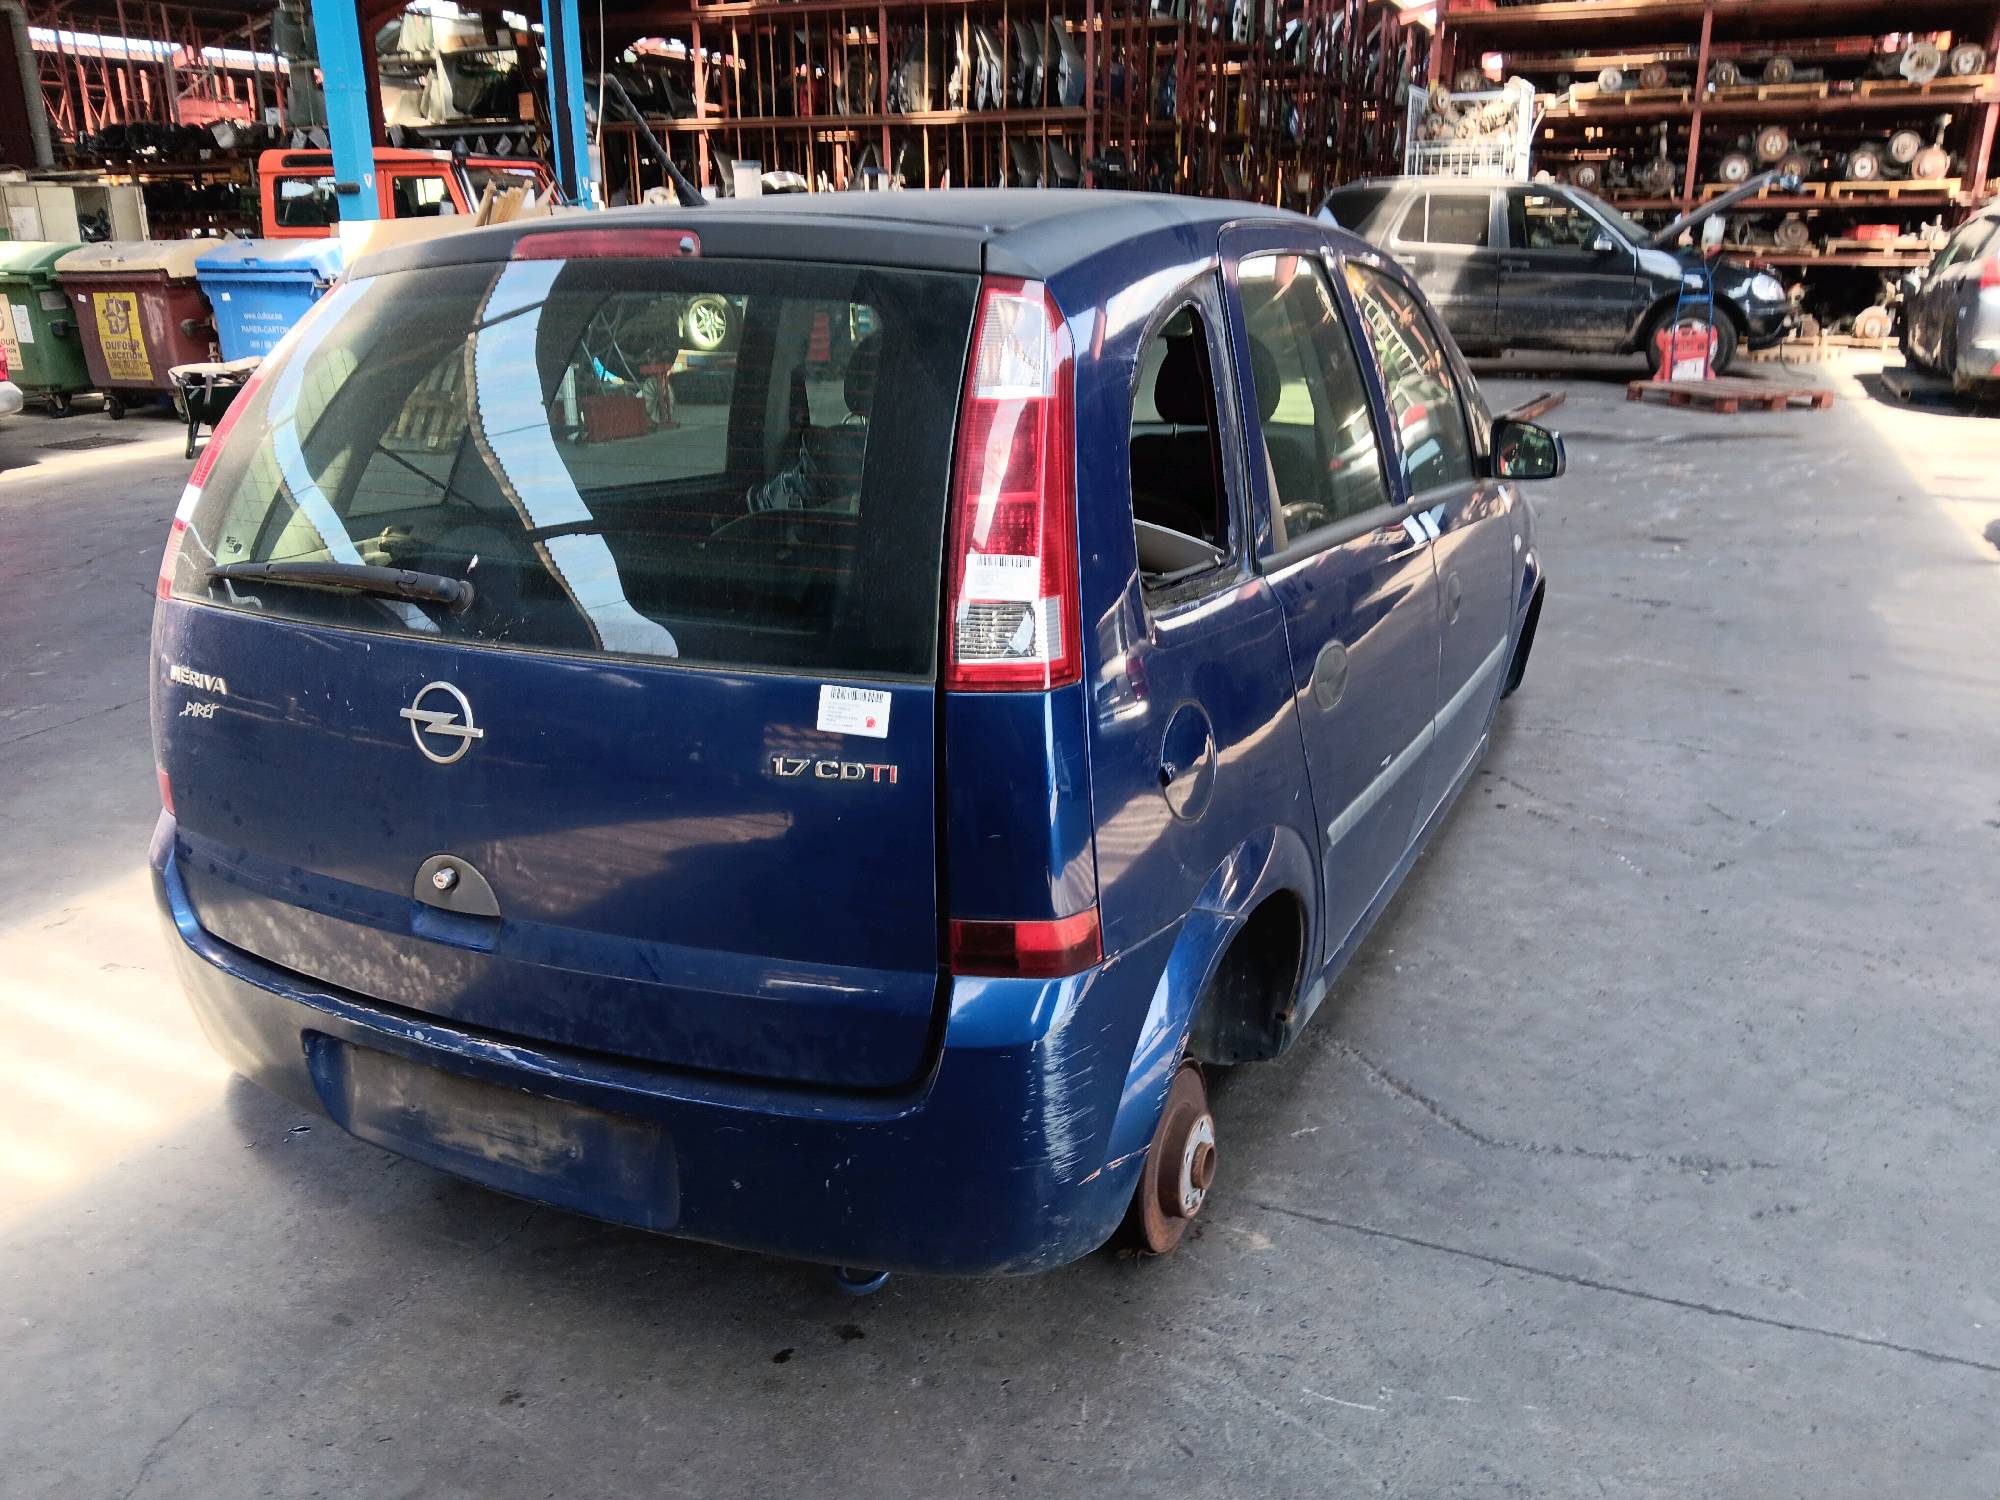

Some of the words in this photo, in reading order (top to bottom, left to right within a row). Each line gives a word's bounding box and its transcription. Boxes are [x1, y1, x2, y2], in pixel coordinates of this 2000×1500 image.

[105, 340, 140, 351] DUFOUR
[107, 351, 143, 360] LOCATION
[814, 760, 898, 785] CDTI
